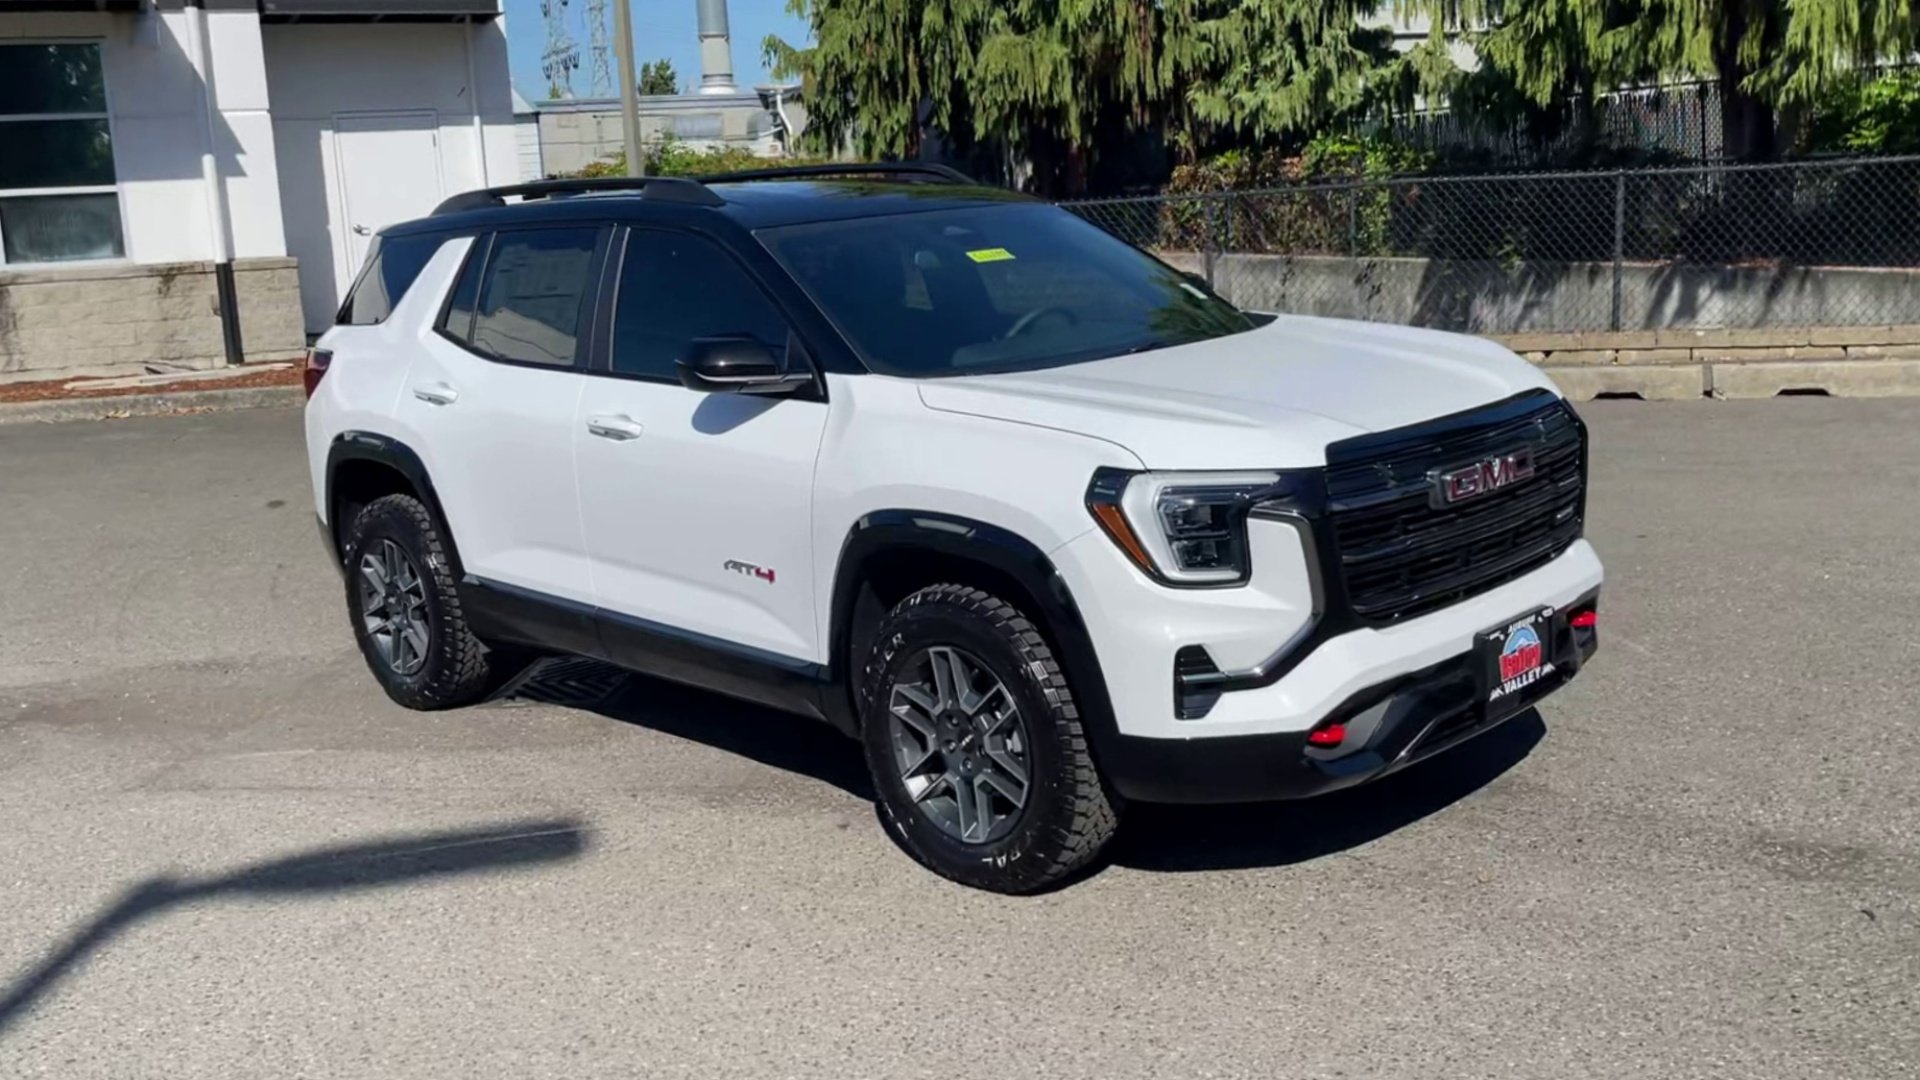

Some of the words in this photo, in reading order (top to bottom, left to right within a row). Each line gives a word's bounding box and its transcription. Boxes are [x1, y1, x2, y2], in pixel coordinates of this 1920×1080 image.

[1447, 448, 1535, 502] GMC
[723, 559, 775, 585] AT4
[1503, 666, 1541, 695] VALLEY
